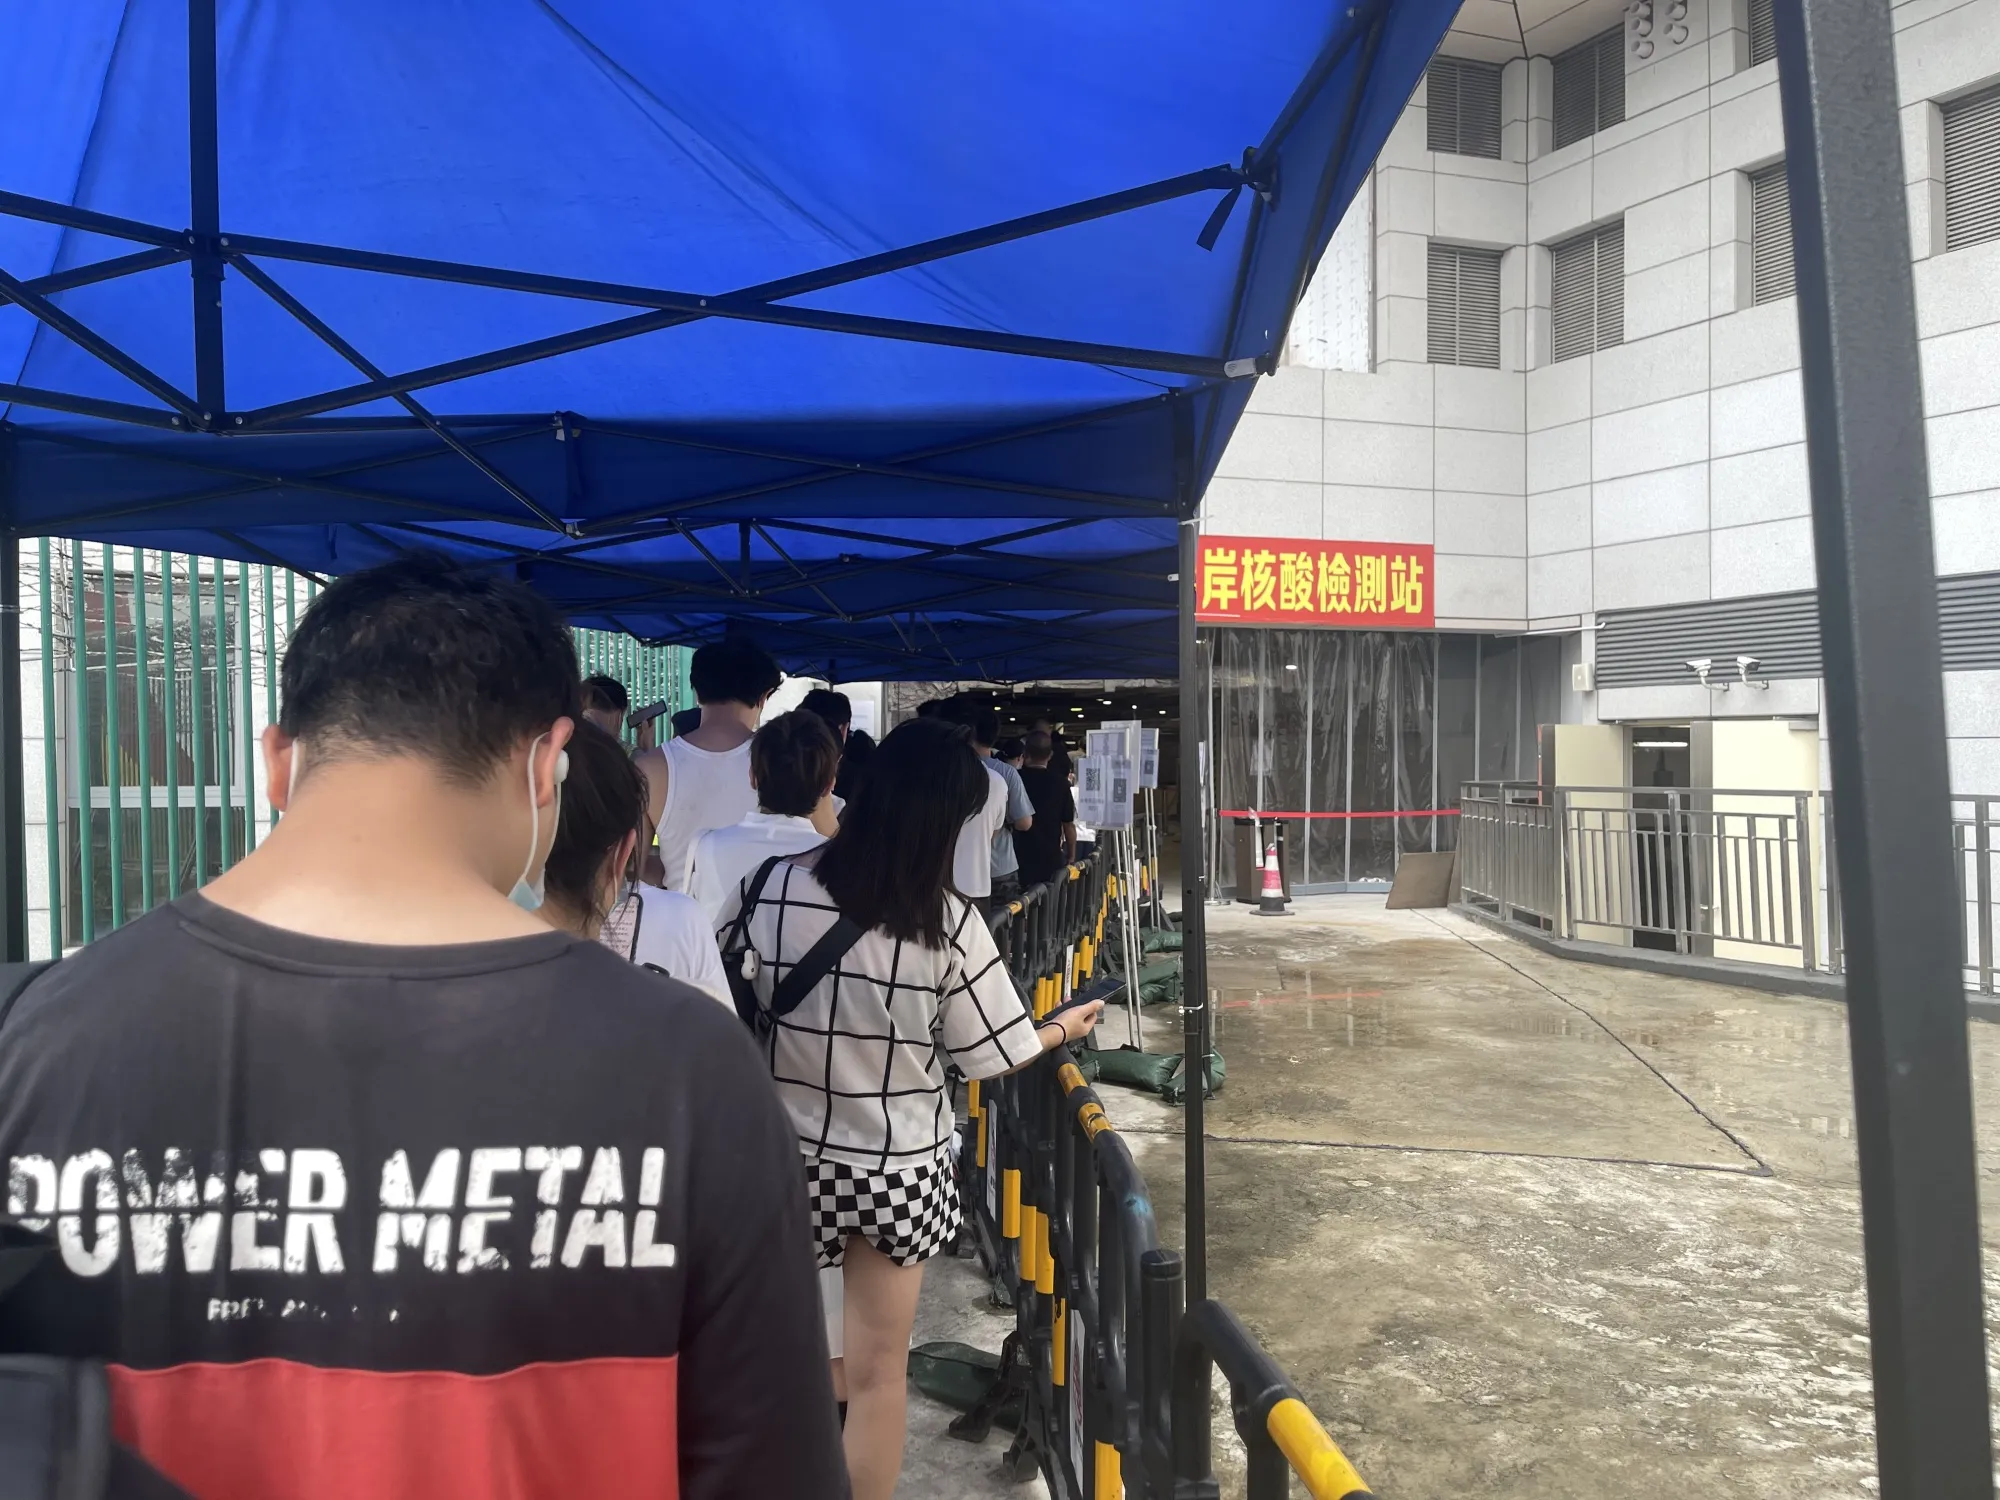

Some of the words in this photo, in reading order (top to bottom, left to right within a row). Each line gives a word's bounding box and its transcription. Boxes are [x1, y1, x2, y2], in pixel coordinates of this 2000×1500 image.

[1202, 547, 1423, 614] 岸核酸檢測站
[8, 1146, 348, 1277] POWER
[372, 1146, 677, 1274] METAL
